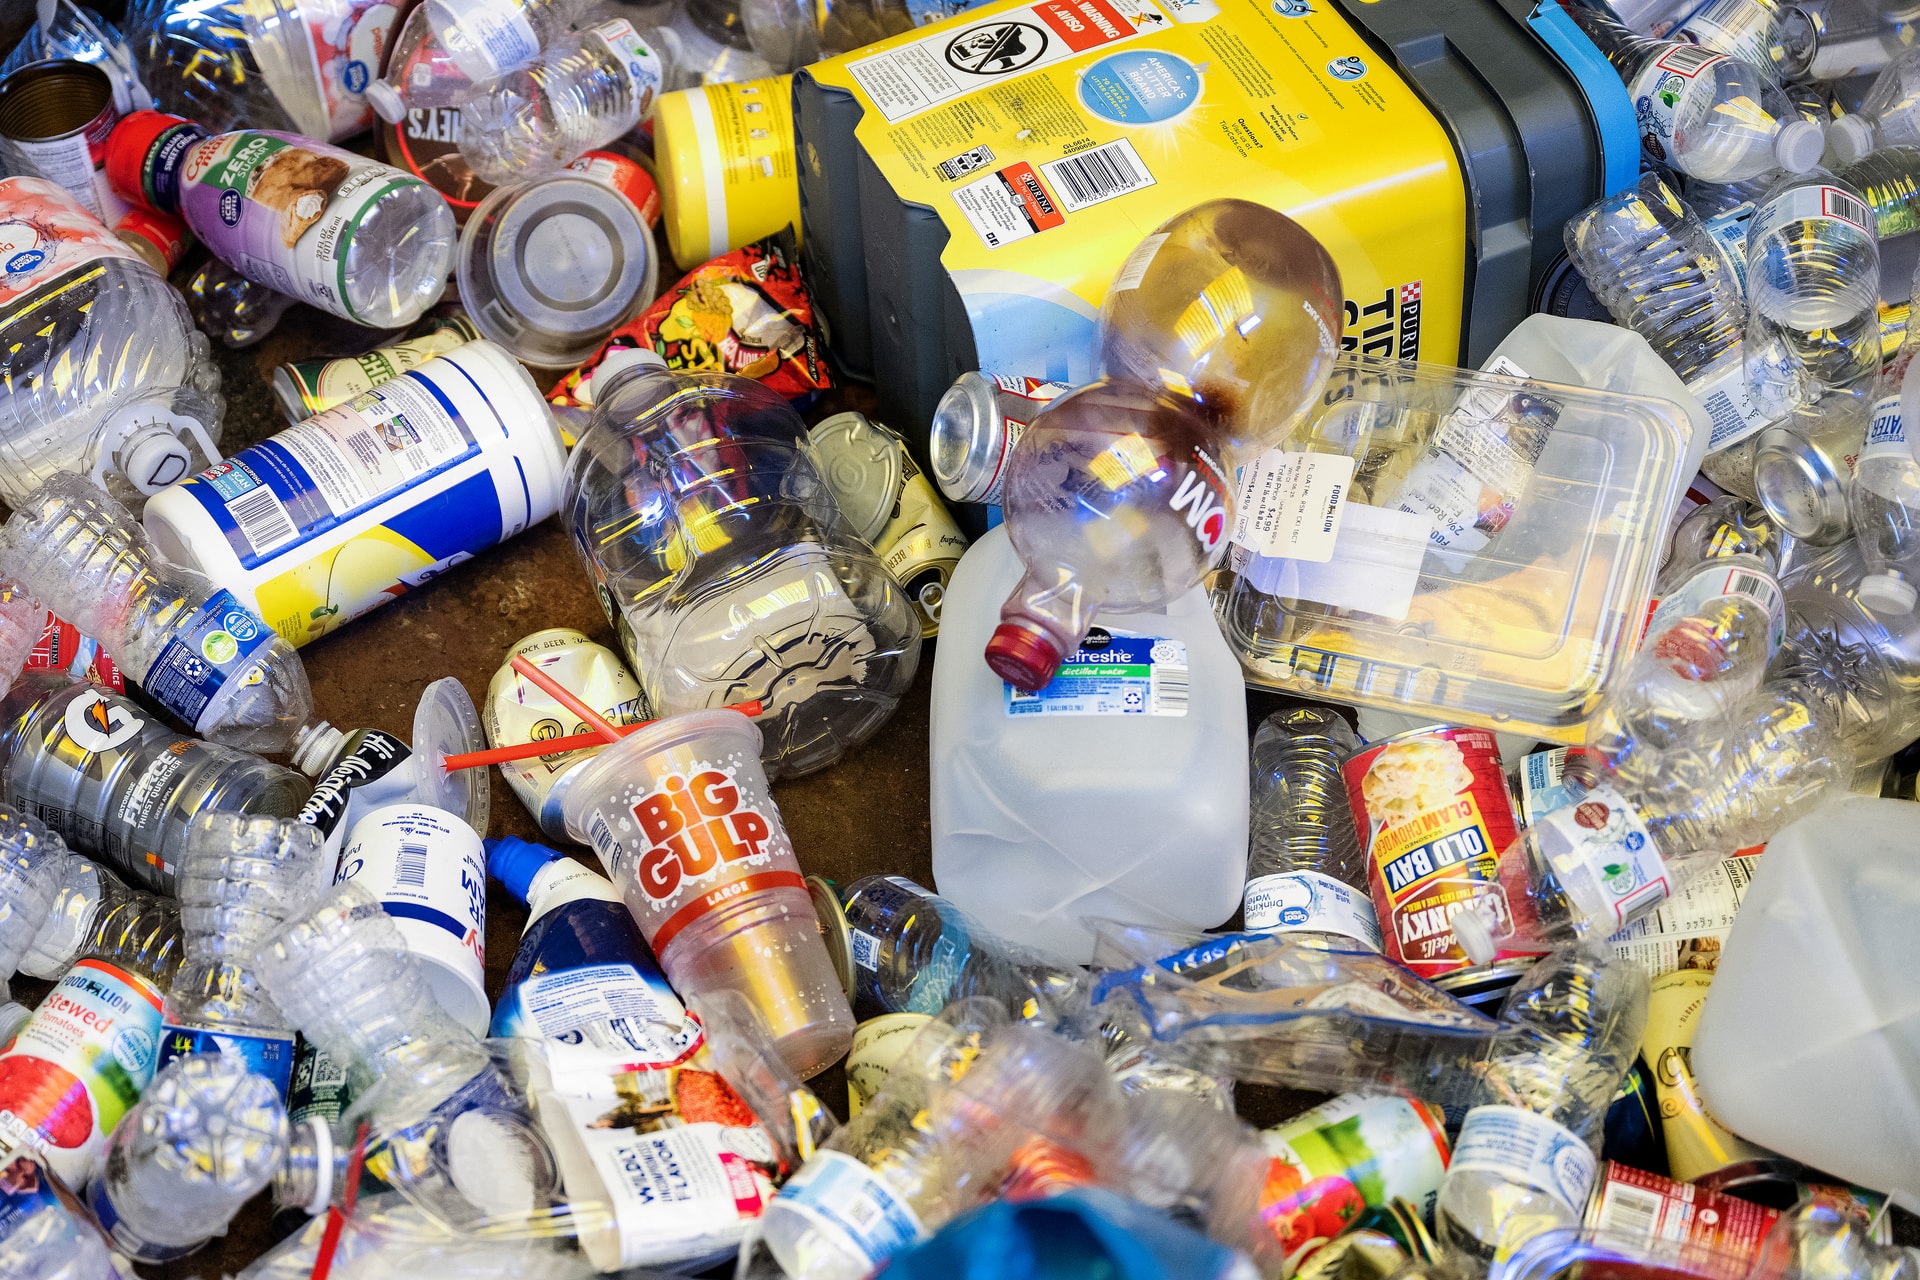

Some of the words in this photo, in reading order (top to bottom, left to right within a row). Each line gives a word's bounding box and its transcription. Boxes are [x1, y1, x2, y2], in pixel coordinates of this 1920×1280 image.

[1055, 10, 1085, 32] AVISO
[1077, 0, 1121, 39] WARNING
[1129, 71, 1156, 99] BRAND
[1143, 68, 1172, 98] LITTER
[1147, 56, 1187, 99] AMERICA'S
[1091, 75, 1106, 92] LITTER
[1105, 92, 1127, 118] EXPERTISE
[1108, 84, 1123, 102] YEARS
[1063, 136, 1090, 150] GL6614
[1220, 121, 1247, 158] TidyCats.com
[1238, 118, 1263, 149] Questions?
[1247, 142, 1253, 150] at
[220, 138, 268, 186] ZERO
[238, 145, 269, 178] SUGAR
[225, 195, 233, 220] ICED
[1027, 179, 1055, 215] PURINA
[398, 413, 419, 442] Electronics
[231, 468, 250, 490] SCAN
[1266, 471, 1274, 481] NET
[1275, 463, 1286, 482] Total
[1301, 473, 1311, 498] OATML
[1271, 482, 1281, 501] Price
[1329, 483, 1341, 505] FOOD
[1262, 506, 1275, 532] $4.99
[1322, 515, 1333, 533] LION
[1446, 518, 1465, 536] 2%
[888, 549, 907, 569] BEER
[234, 618, 251, 637] HEALTHY
[544, 639, 566, 649] BEER
[1062, 664, 1098, 676] distilled
[1100, 667, 1128, 676] water
[123, 749, 177, 828] FIERCE
[301, 731, 396, 824] Hi-Neighbo
[117, 781, 136, 819] GATORADE
[138, 795, 154, 829] THIRST
[149, 760, 183, 798] QUENCHER
[161, 787, 173, 804] APPLE
[1415, 799, 1473, 832] CLAM
[1374, 817, 1421, 858] CHOWDER
[1403, 830, 1444, 851] SEASONED
[1432, 826, 1485, 859] OLD
[638, 811, 770, 901] GULP
[1386, 849, 1435, 892] BAY
[1725, 860, 1743, 888] Calories
[706, 880, 750, 907] LARGE
[1245, 895, 1283, 917] Drinking
[1283, 911, 1307, 923] Great
[42, 992, 114, 1034] Stewed
[100, 988, 132, 1014] LION
[40, 1011, 86, 1039] Tomatoes
[120, 1032, 136, 1056] MONEY
[133, 1052, 145, 1067] BACK
